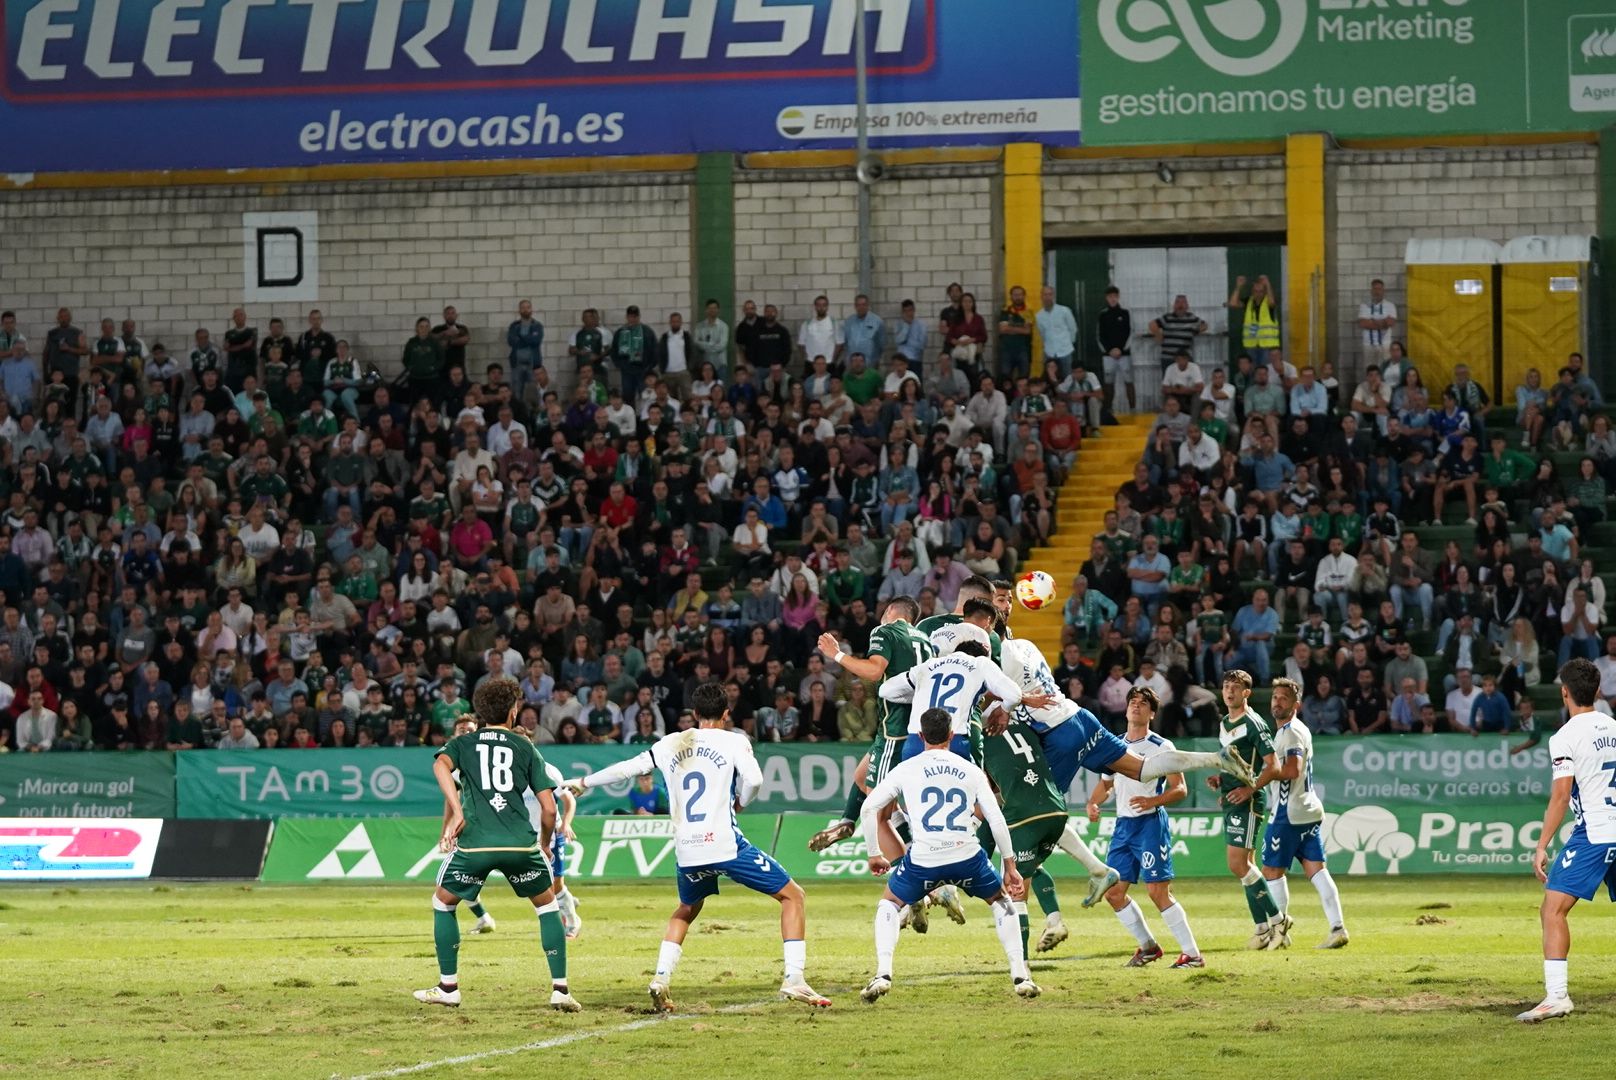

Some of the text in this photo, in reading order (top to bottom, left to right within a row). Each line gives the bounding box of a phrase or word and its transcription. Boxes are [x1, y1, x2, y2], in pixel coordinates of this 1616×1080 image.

[1317, 11, 1475, 44] Marketing
[1099, 76, 1477, 124] gestionamos tu energía
[299, 103, 625, 152] electrocash.es
[896, 111, 938, 128] 100%
[941, 107, 1038, 125] extremeña
[256, 226, 304, 288] D
[929, 672, 965, 714] 12
[479, 731, 499, 742] RAÚL
[1002, 729, 1036, 764] 4
[475, 743, 515, 793] 18
[696, 746, 728, 770] RGUEZ
[923, 765, 966, 780] ÁLVARO
[1342, 740, 1549, 778] Corrugados
[18, 776, 135, 799] ¡Marca un gol
[682, 770, 707, 823] 2
[1343, 775, 1543, 801] Paneles y aceros de
[72, 801, 134, 818] futuro!
[920, 786, 968, 832] 22
[815, 859, 869, 876] 670
[1431, 850, 1450, 864] Tu
[1454, 852, 1512, 864] centro
